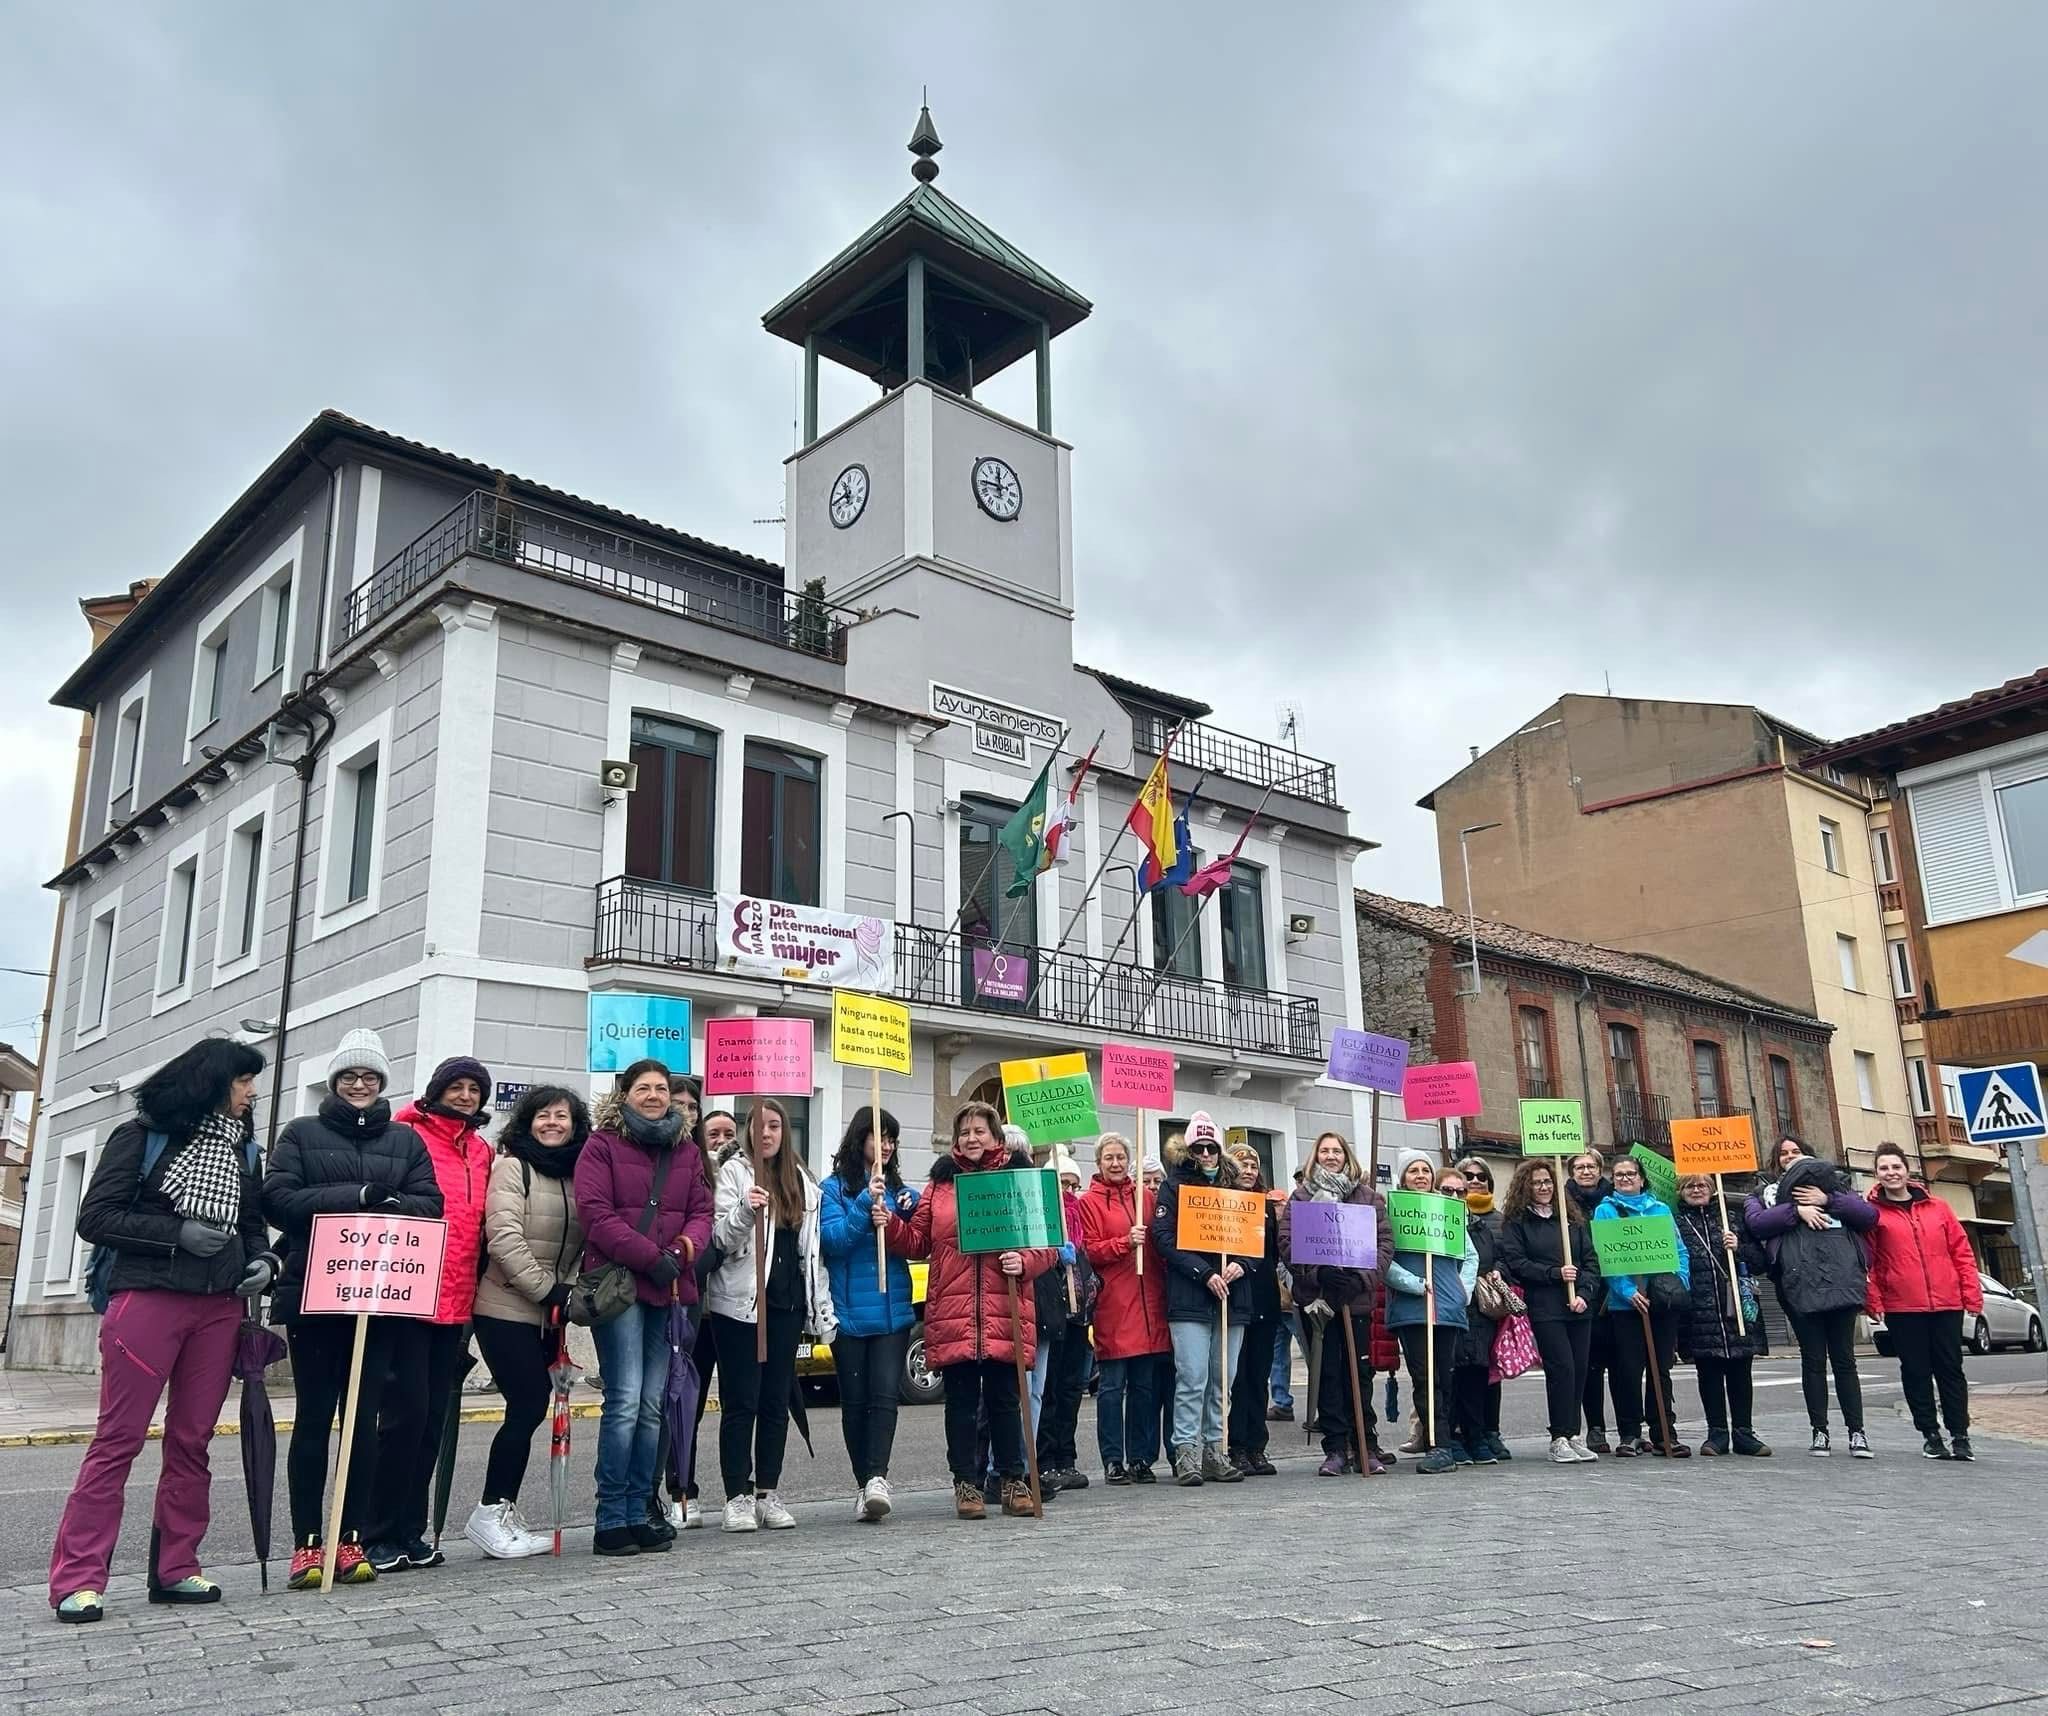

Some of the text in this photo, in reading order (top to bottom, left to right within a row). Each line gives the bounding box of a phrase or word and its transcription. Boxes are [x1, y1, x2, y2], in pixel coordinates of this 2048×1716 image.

[939, 694, 1056, 738] Ayuntamiento
[979, 729, 1021, 756] LA ROBLA
[751, 901, 765, 955] MARZO
[768, 917, 858, 940] Internacional
[770, 932, 799, 944] de la
[771, 940, 841, 969] mujer
[840, 1006, 906, 1028] Ninguna es libre
[599, 1022, 685, 1042] ¡Quiérete!
[840, 1023, 905, 1044] hasta que todas
[775, 1036, 787, 1046] de
[1341, 1038, 1401, 1057] IGUALDAD
[716, 1052, 801, 1064] de la vida y luego
[841, 1043, 906, 1061] seamos LIBRES
[1109, 1052, 1138, 1064] VIVAS,
[712, 1069, 725, 1079] de
[727, 1069, 755, 1080] quien
[770, 1069, 807, 1079] quieras
[1114, 1067, 1164, 1080] UNIDAS POR
[1111, 1080, 1167, 1093] LA IGUALDAD
[1016, 1084, 1084, 1104] IGUALDAD
[1022, 1100, 1085, 1118] EN EL ACCESO
[1028, 1121, 1040, 1130] AL
[1535, 1114, 1574, 1126] JUNTAS,
[1552, 1130, 1581, 1141] fuertes
[1701, 1126, 1722, 1136] SIN
[1682, 1139, 1746, 1152] NOSOTRAS
[1723, 1153, 1752, 1161] MUNDO
[1638, 1153, 1676, 1180] IGUALD
[1025, 1188, 1035, 1198] de
[1188, 1195, 1257, 1212] IGUALDAD
[968, 1208, 978, 1217] de
[982, 1207, 991, 1216] la
[994, 1206, 1014, 1216] vida
[1324, 1211, 1345, 1223] NO
[1393, 1208, 1460, 1225] Lucha por la
[1208, 1213, 1249, 1224] DERECHOS
[966, 1226, 976, 1235] de
[980, 1224, 1007, 1235] quien
[1023, 1223, 1057, 1232] quieras
[1399, 1224, 1455, 1241] IGUALDAD
[1622, 1225, 1643, 1236] SIN
[339, 1228, 420, 1248] Soy de la
[1314, 1247, 1355, 1258] LABORAL
[1603, 1239, 1669, 1253] NOSOTRAS
[1613, 1256, 1634, 1264] PARA
[1644, 1253, 1674, 1262] MUNDO
[326, 1257, 425, 1275] generación
[336, 1283, 412, 1302] igualdad
